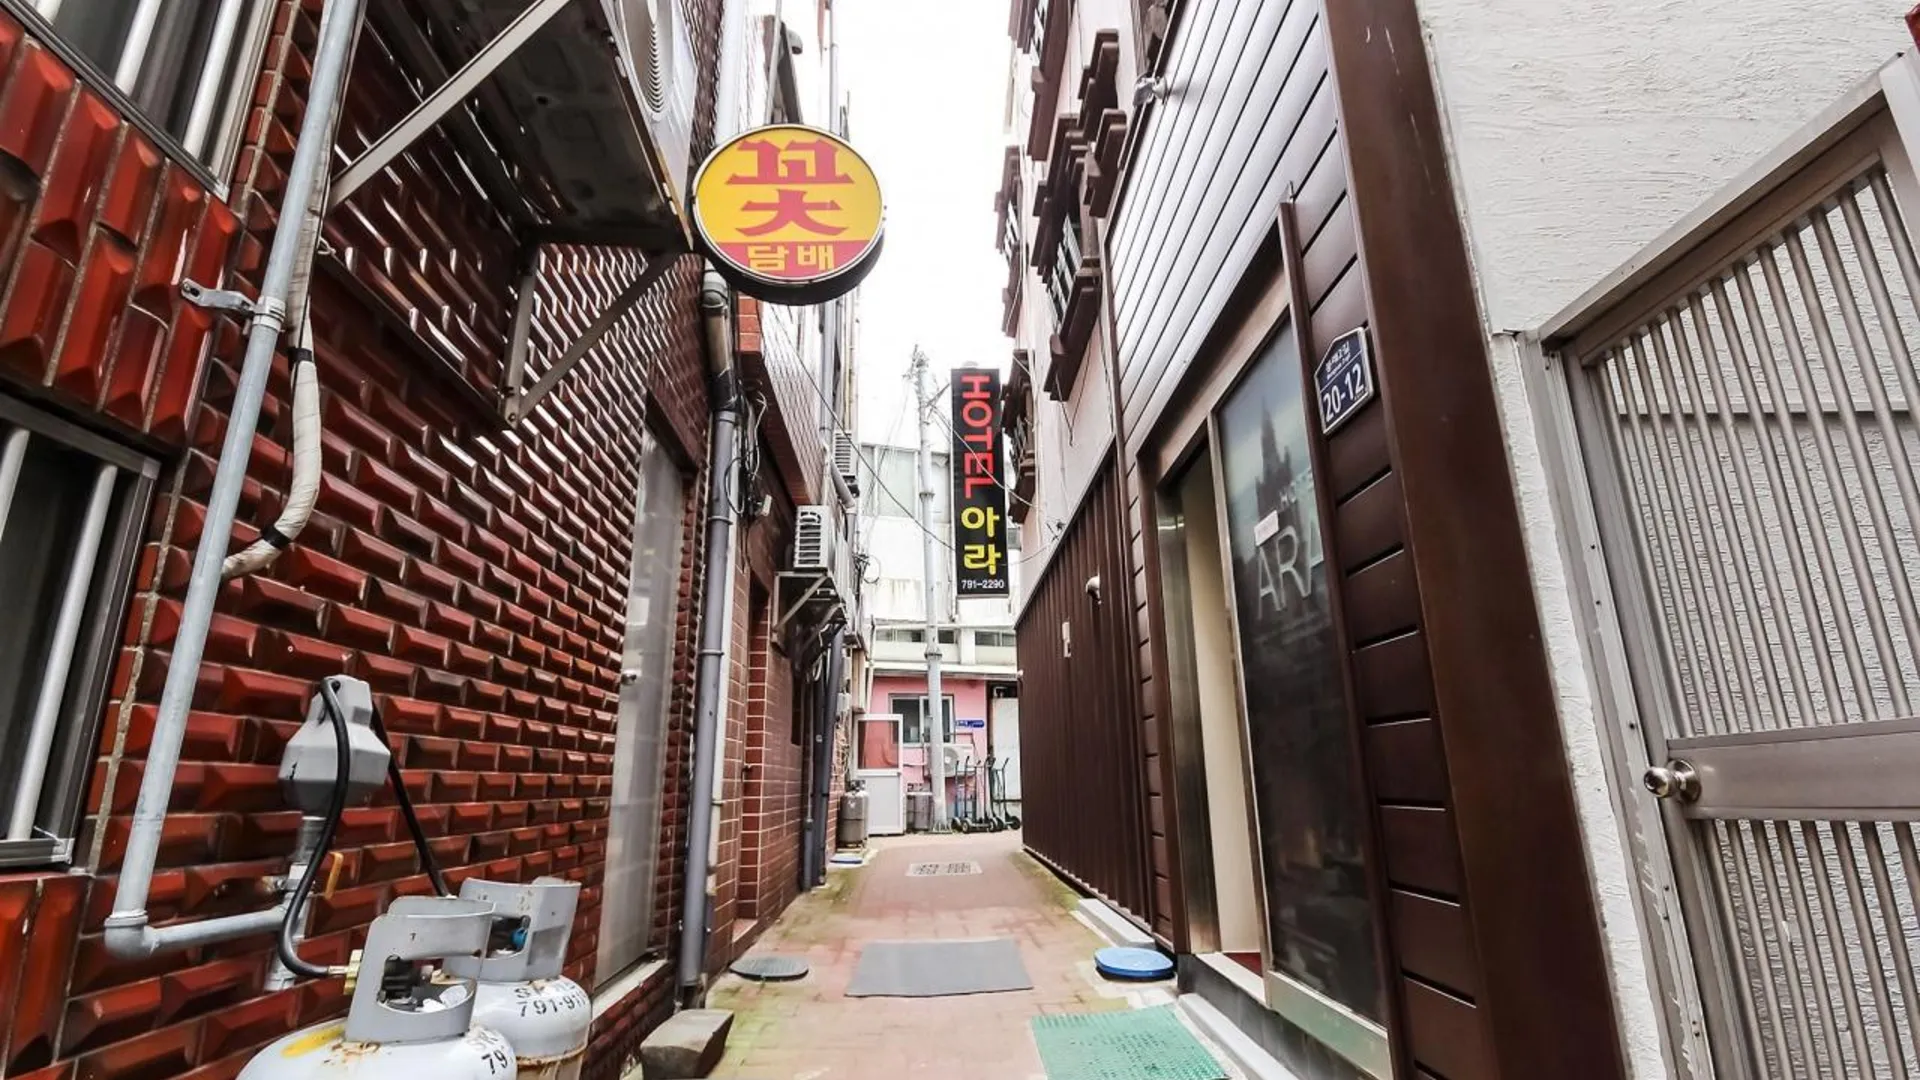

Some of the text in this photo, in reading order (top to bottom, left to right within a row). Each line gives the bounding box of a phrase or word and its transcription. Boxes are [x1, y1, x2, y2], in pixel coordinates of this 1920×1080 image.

[724, 138, 855, 236] 꽃
[747, 245, 835, 271] 담배
[1323, 363, 1364, 422] 20-12
[960, 374, 994, 499] HOTEL
[961, 506, 1002, 576] 아라
[961, 579, 1005, 590] 791-2290
